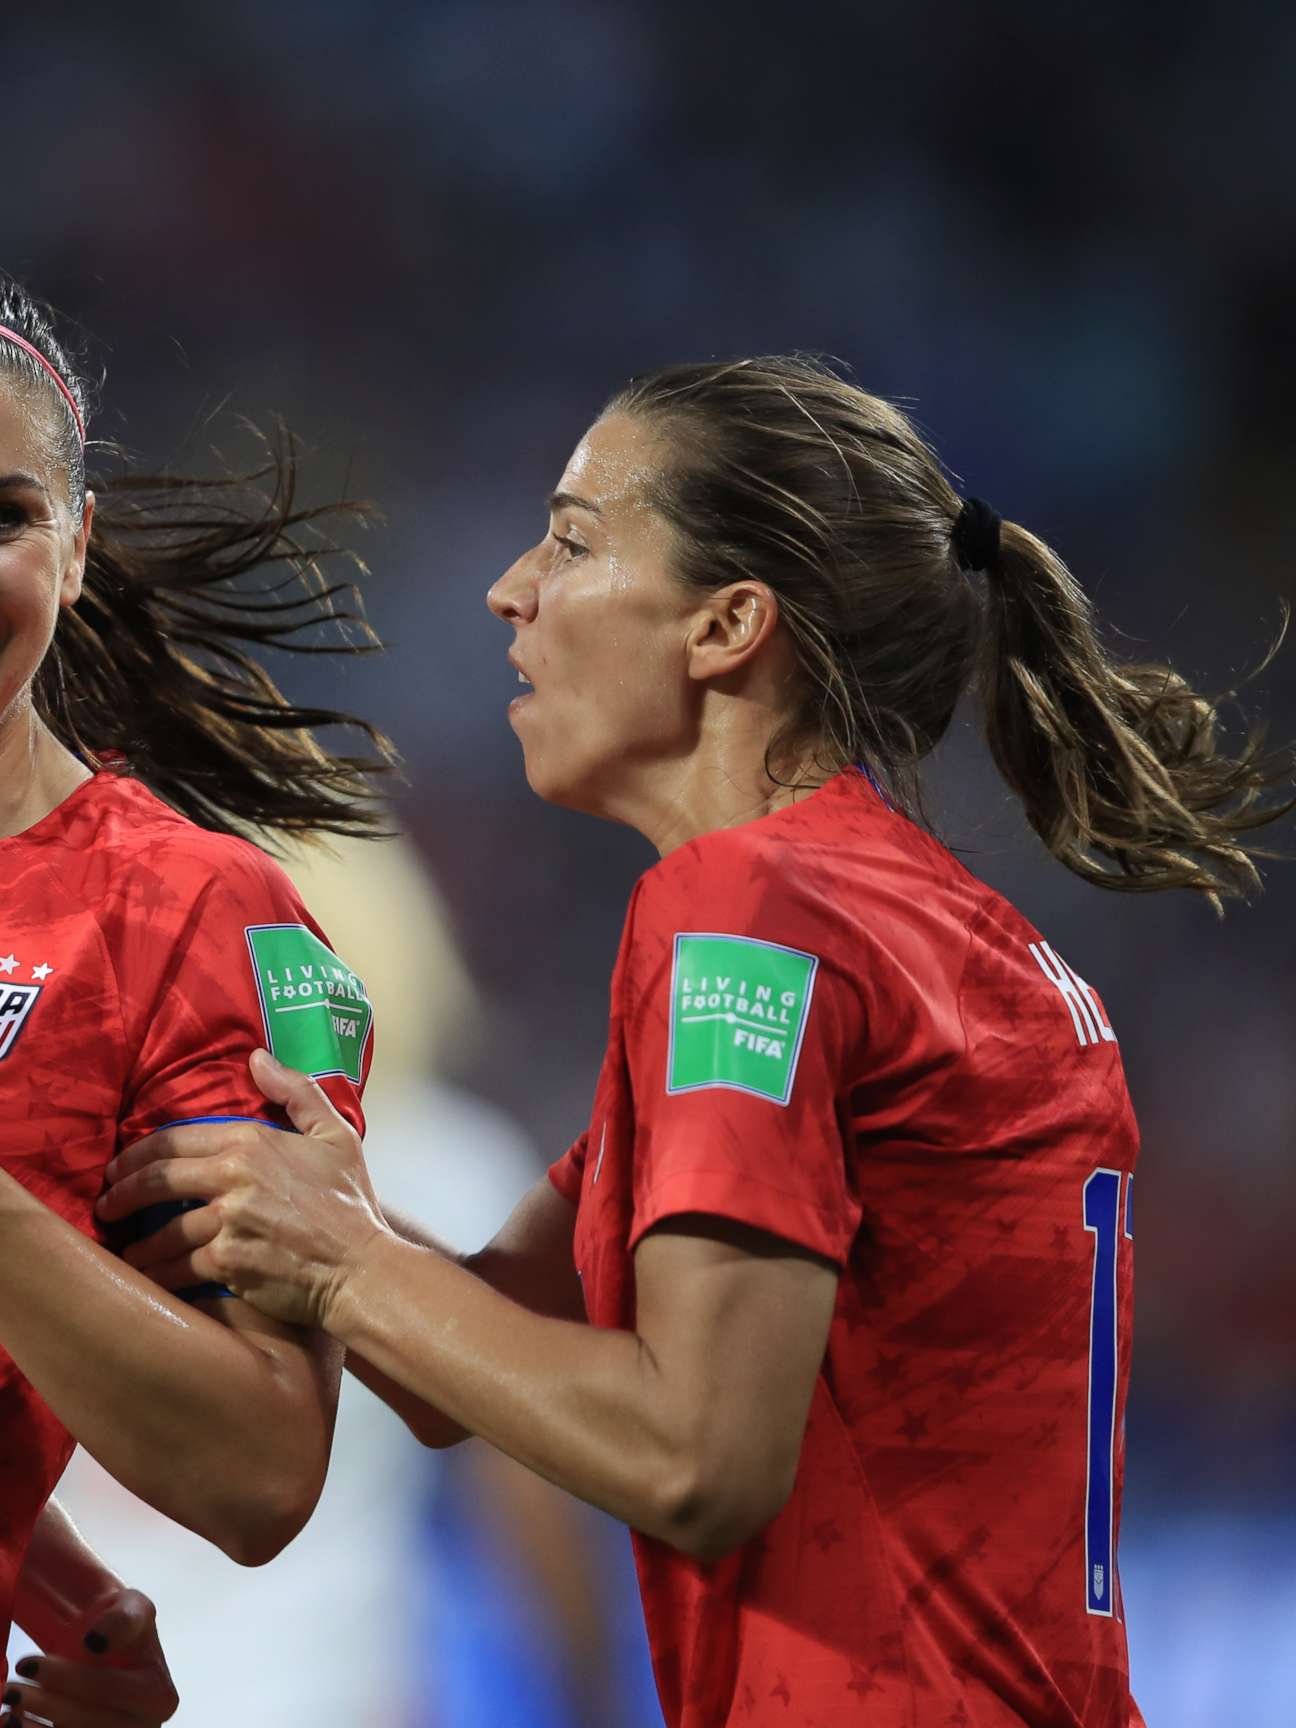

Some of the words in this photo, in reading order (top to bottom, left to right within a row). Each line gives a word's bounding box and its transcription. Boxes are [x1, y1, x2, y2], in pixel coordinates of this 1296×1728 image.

[267, 964, 357, 985] LIVING
[271, 980, 366, 1001] FOOTBALL
[682, 976, 796, 1007] LIVING
[682, 993, 790, 1025] FOOTBALL
[734, 1029, 784, 1059] FIFA
[1083, 1167, 1134, 1620] 1
